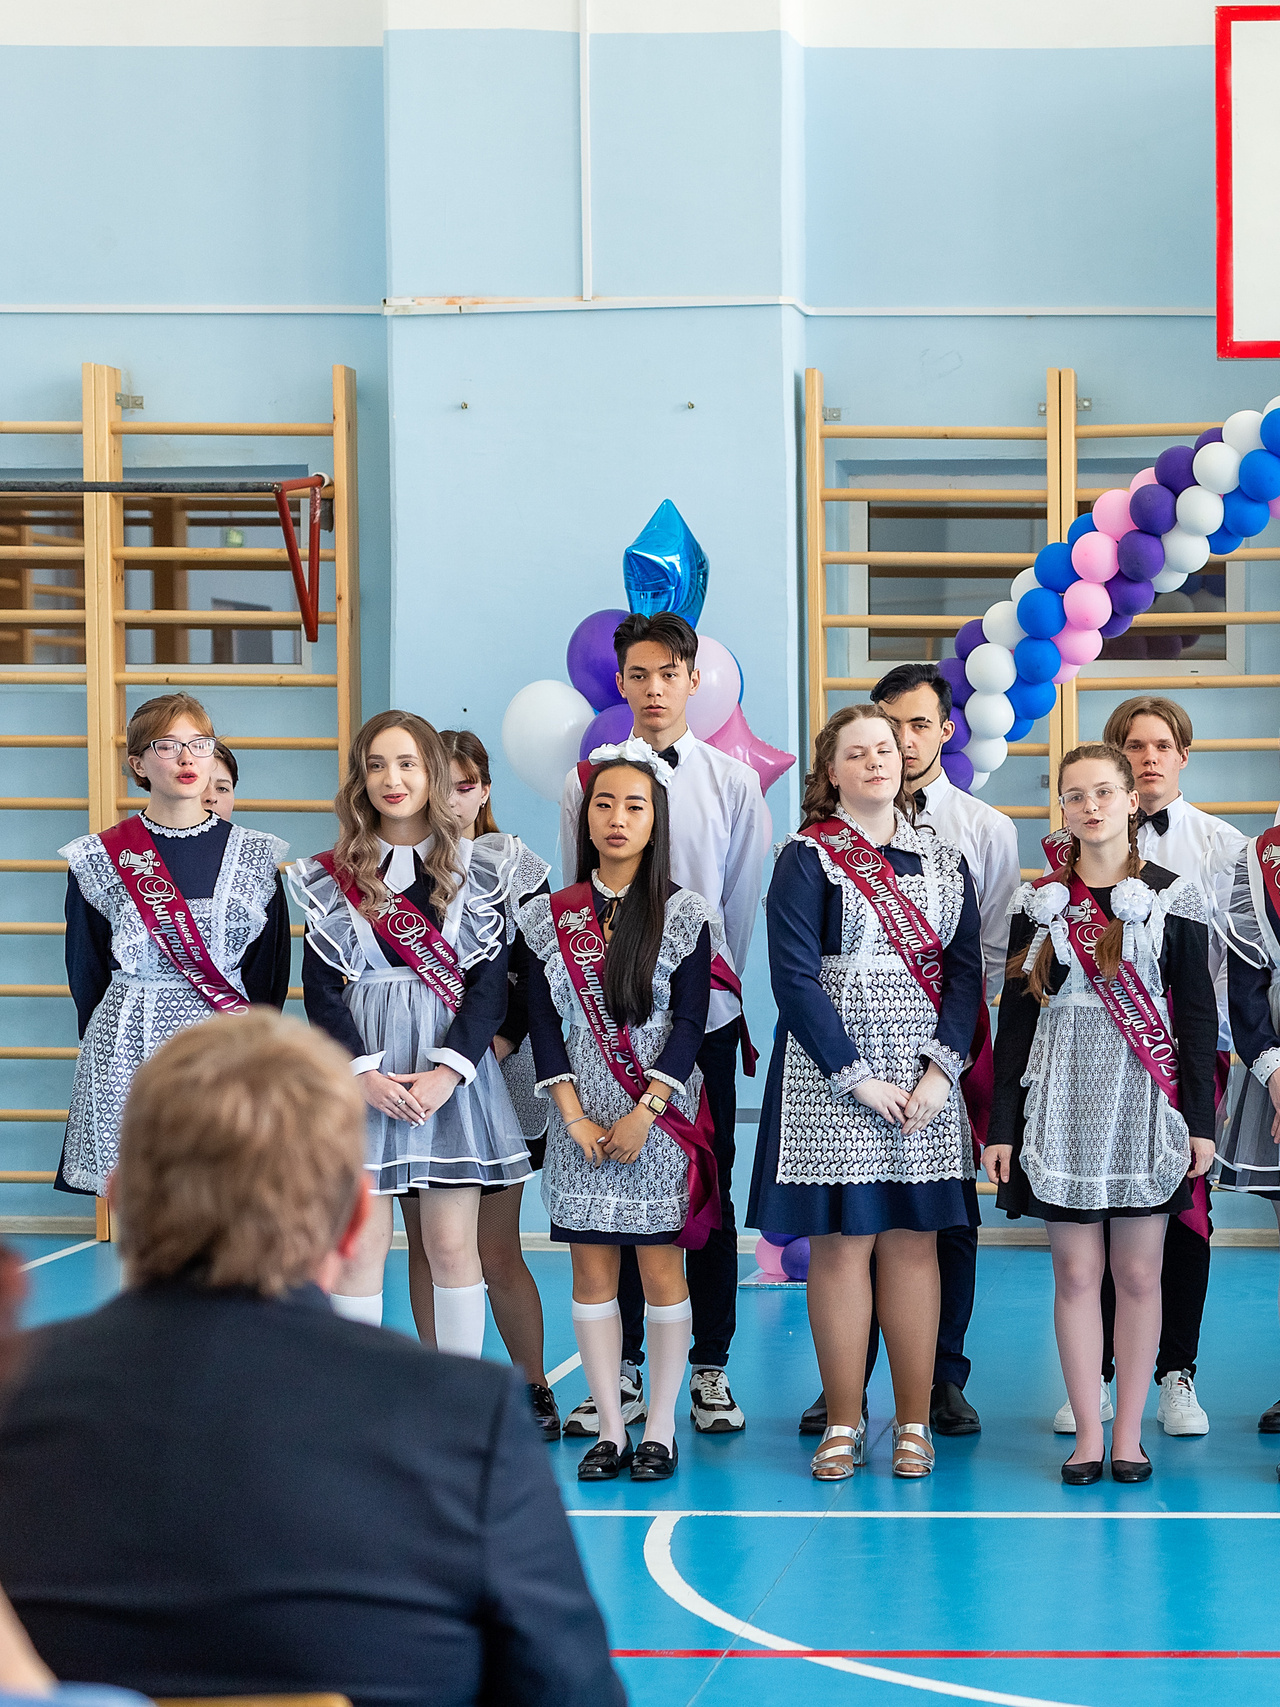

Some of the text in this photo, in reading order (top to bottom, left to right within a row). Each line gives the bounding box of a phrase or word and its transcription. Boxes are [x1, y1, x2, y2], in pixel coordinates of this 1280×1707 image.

[137, 875, 206, 984] Выпускница
[198, 982, 249, 1015] 202
[175, 911, 195, 944] Орлова
[190, 946, 203, 961] Ева
[845, 846, 924, 952] Выпускница
[915, 949, 942, 1002] 202
[909, 910, 933, 945] Наталья
[387, 910, 466, 1008] Выпускни
[432, 940, 454, 964] Плют
[1136, 994, 1158, 1026] Наталья
